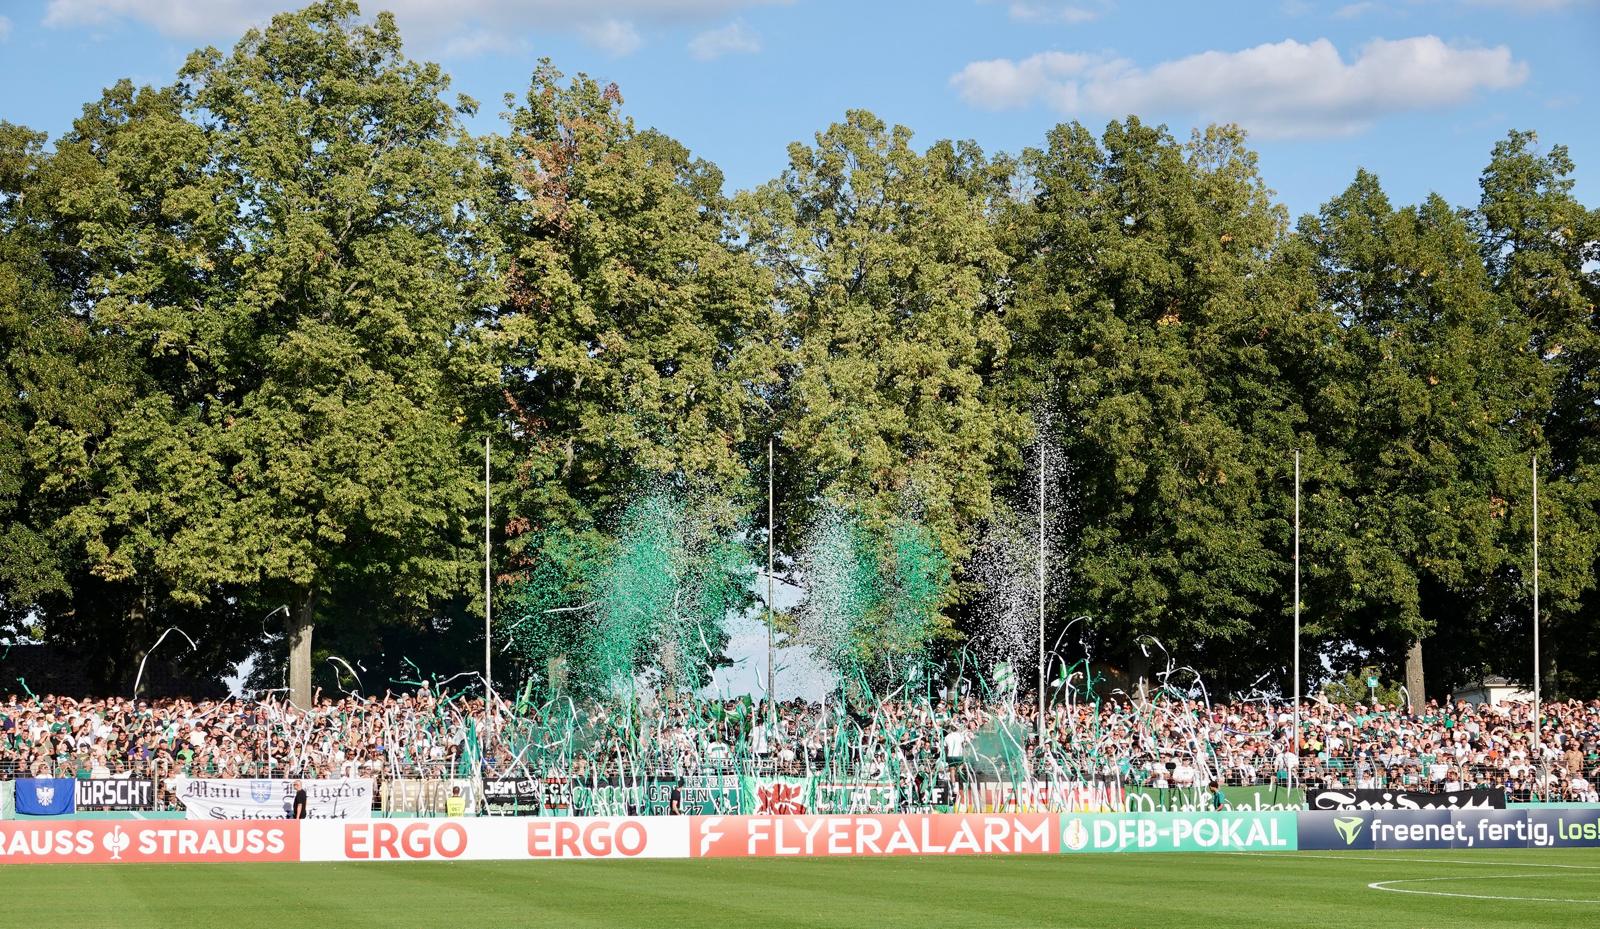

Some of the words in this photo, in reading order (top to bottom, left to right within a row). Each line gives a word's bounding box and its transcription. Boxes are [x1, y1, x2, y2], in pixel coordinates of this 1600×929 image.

[182, 780, 240, 798] Main
[281, 780, 366, 803] Bigade
[484, 780, 517, 795] JSM
[648, 784, 709, 803] GREN
[138, 828, 285, 854] STRAUSS
[344, 822, 468, 858] ERGO
[527, 821, 648, 857] ERGO
[747, 816, 1050, 855] FLYERALARM
[1093, 818, 1287, 848] DFB-POKAL
[1370, 819, 1473, 846] freenet,
[1478, 818, 1554, 846] fertig,
